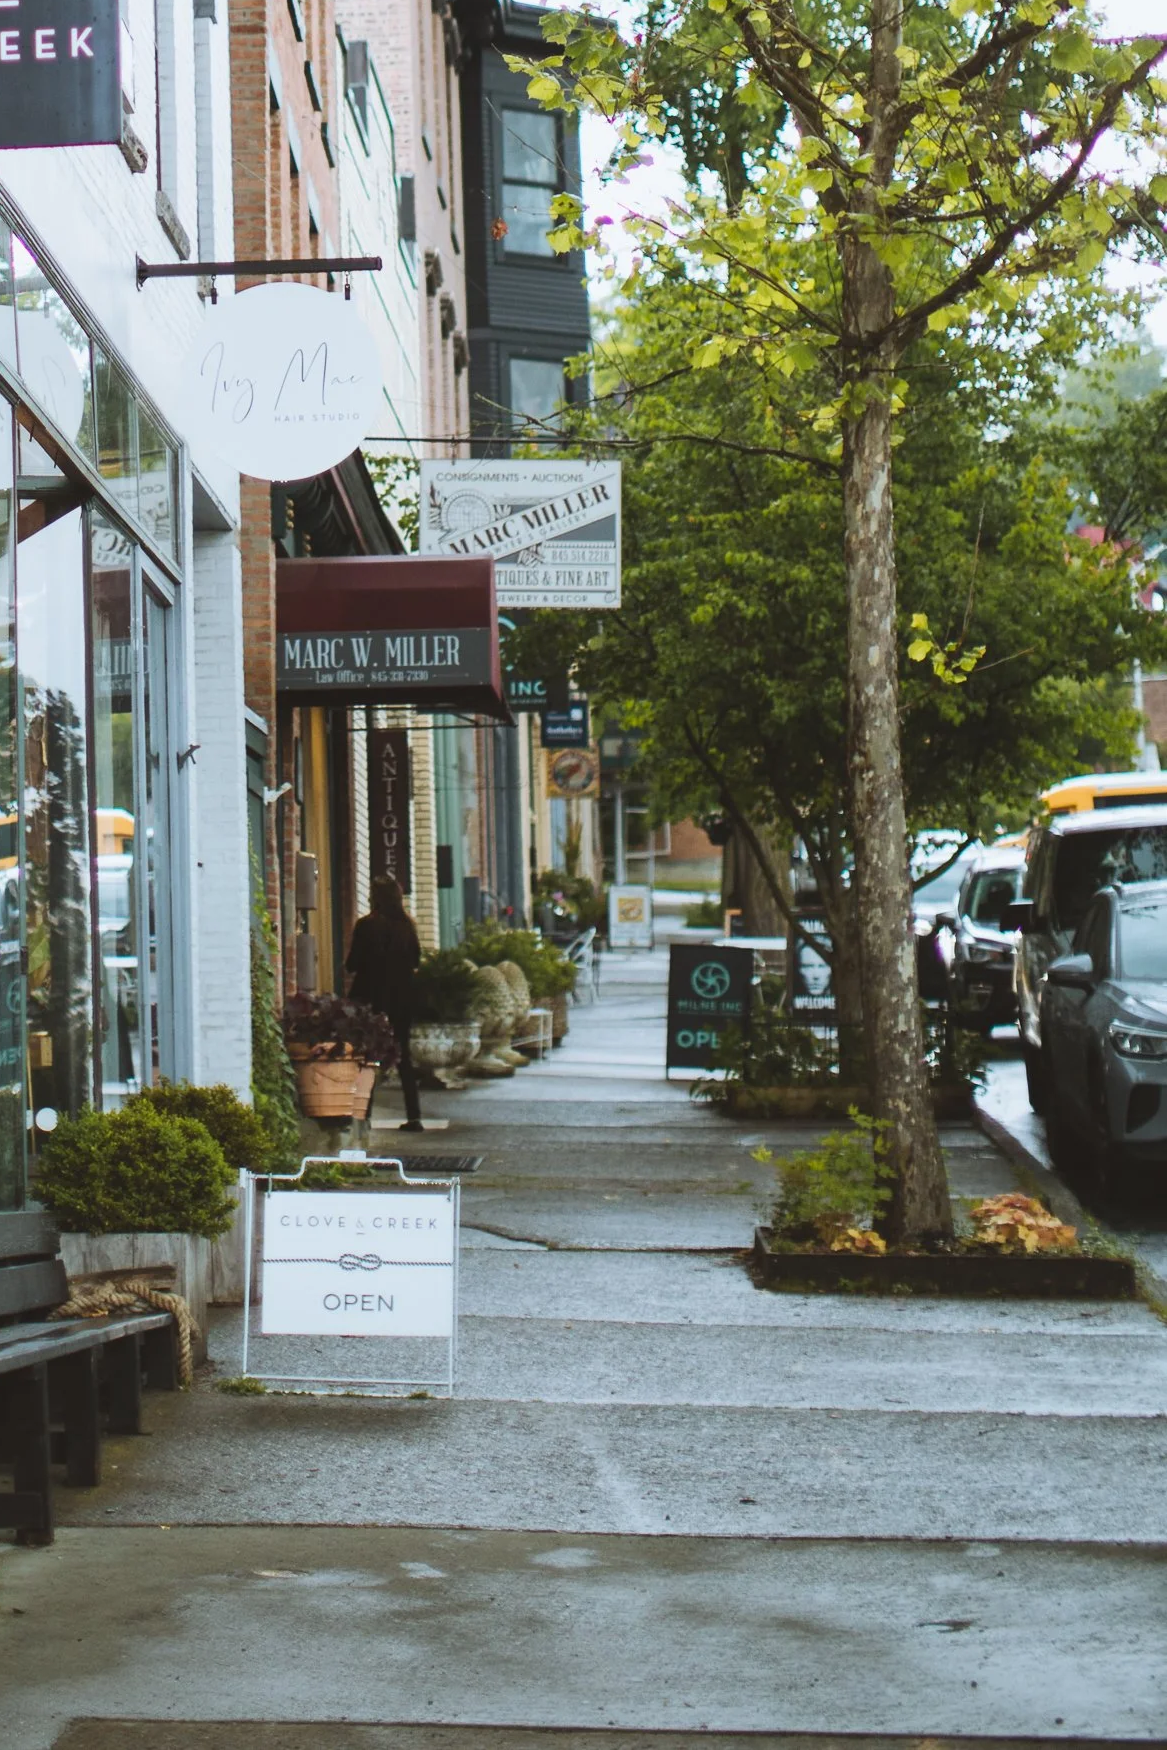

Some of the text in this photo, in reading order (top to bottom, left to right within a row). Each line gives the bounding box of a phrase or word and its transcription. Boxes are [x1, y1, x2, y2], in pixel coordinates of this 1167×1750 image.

[200, 342, 256, 424] Ivy
[274, 413, 360, 422] HAIR STUDIO
[436, 472, 584, 483] CONSIGNMENTS AUCTIONS
[449, 483, 610, 554] MARC MILLER
[496, 570, 610, 587] TIQUES & FINE ART
[553, 594, 588, 603] DECOR
[284, 635, 460, 669] MARC W. MILLER
[315, 671, 335, 684] Law
[336, 670, 365, 683] Office
[510, 681, 547, 696] INC
[382, 743, 398, 881] ANTIQUES
[280, 1214, 346, 1229] CLOVE
[373, 1216, 438, 1230] CREEK
[323, 1293, 395, 1312] OPEN
